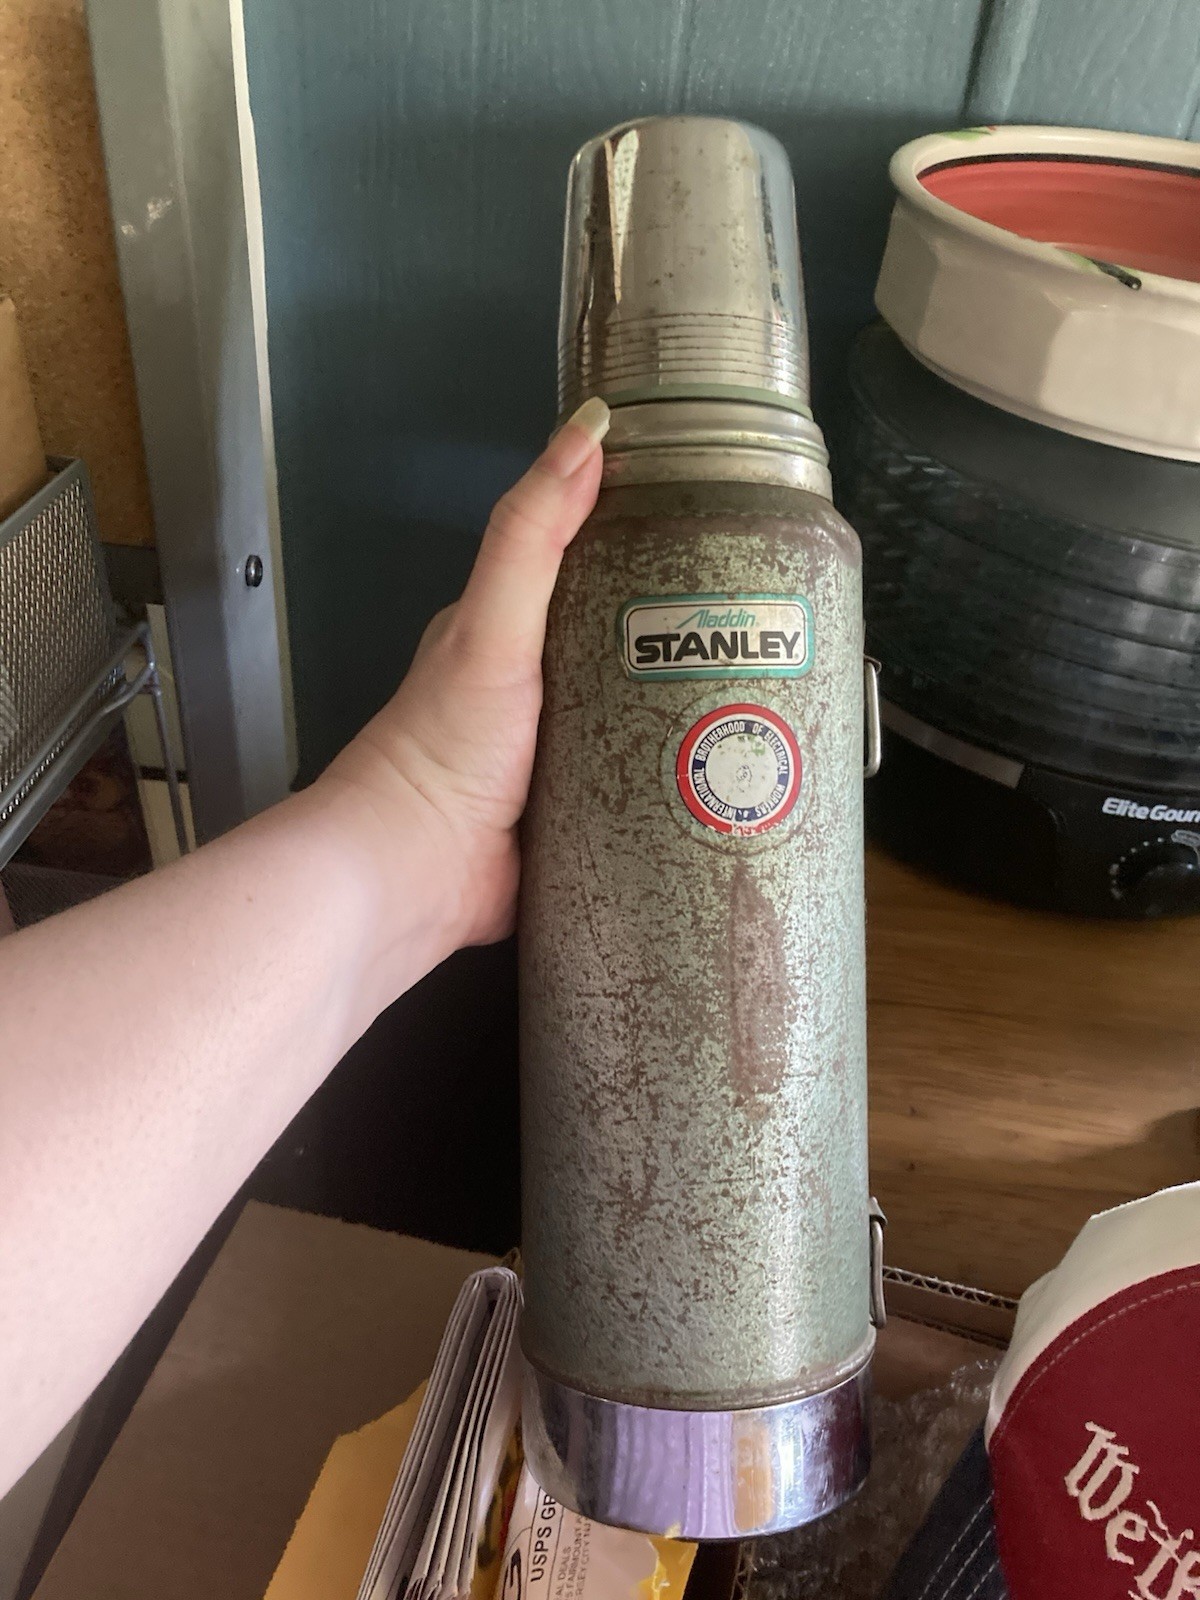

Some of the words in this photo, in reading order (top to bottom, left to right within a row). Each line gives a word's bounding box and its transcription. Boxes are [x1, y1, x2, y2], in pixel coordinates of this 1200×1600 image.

[675, 608, 757, 629] Aladdin
[634, 630, 801, 664] STANLEY
[695, 720, 746, 761] BROTHERHOOD
[752, 722, 764, 735] OF
[763, 731, 788, 775] ELECTRICAL
[693, 767, 737, 821] INTERNATIONAL
[754, 783, 786, 817] WORKERS
[530, 1526, 552, 1582] USPS
